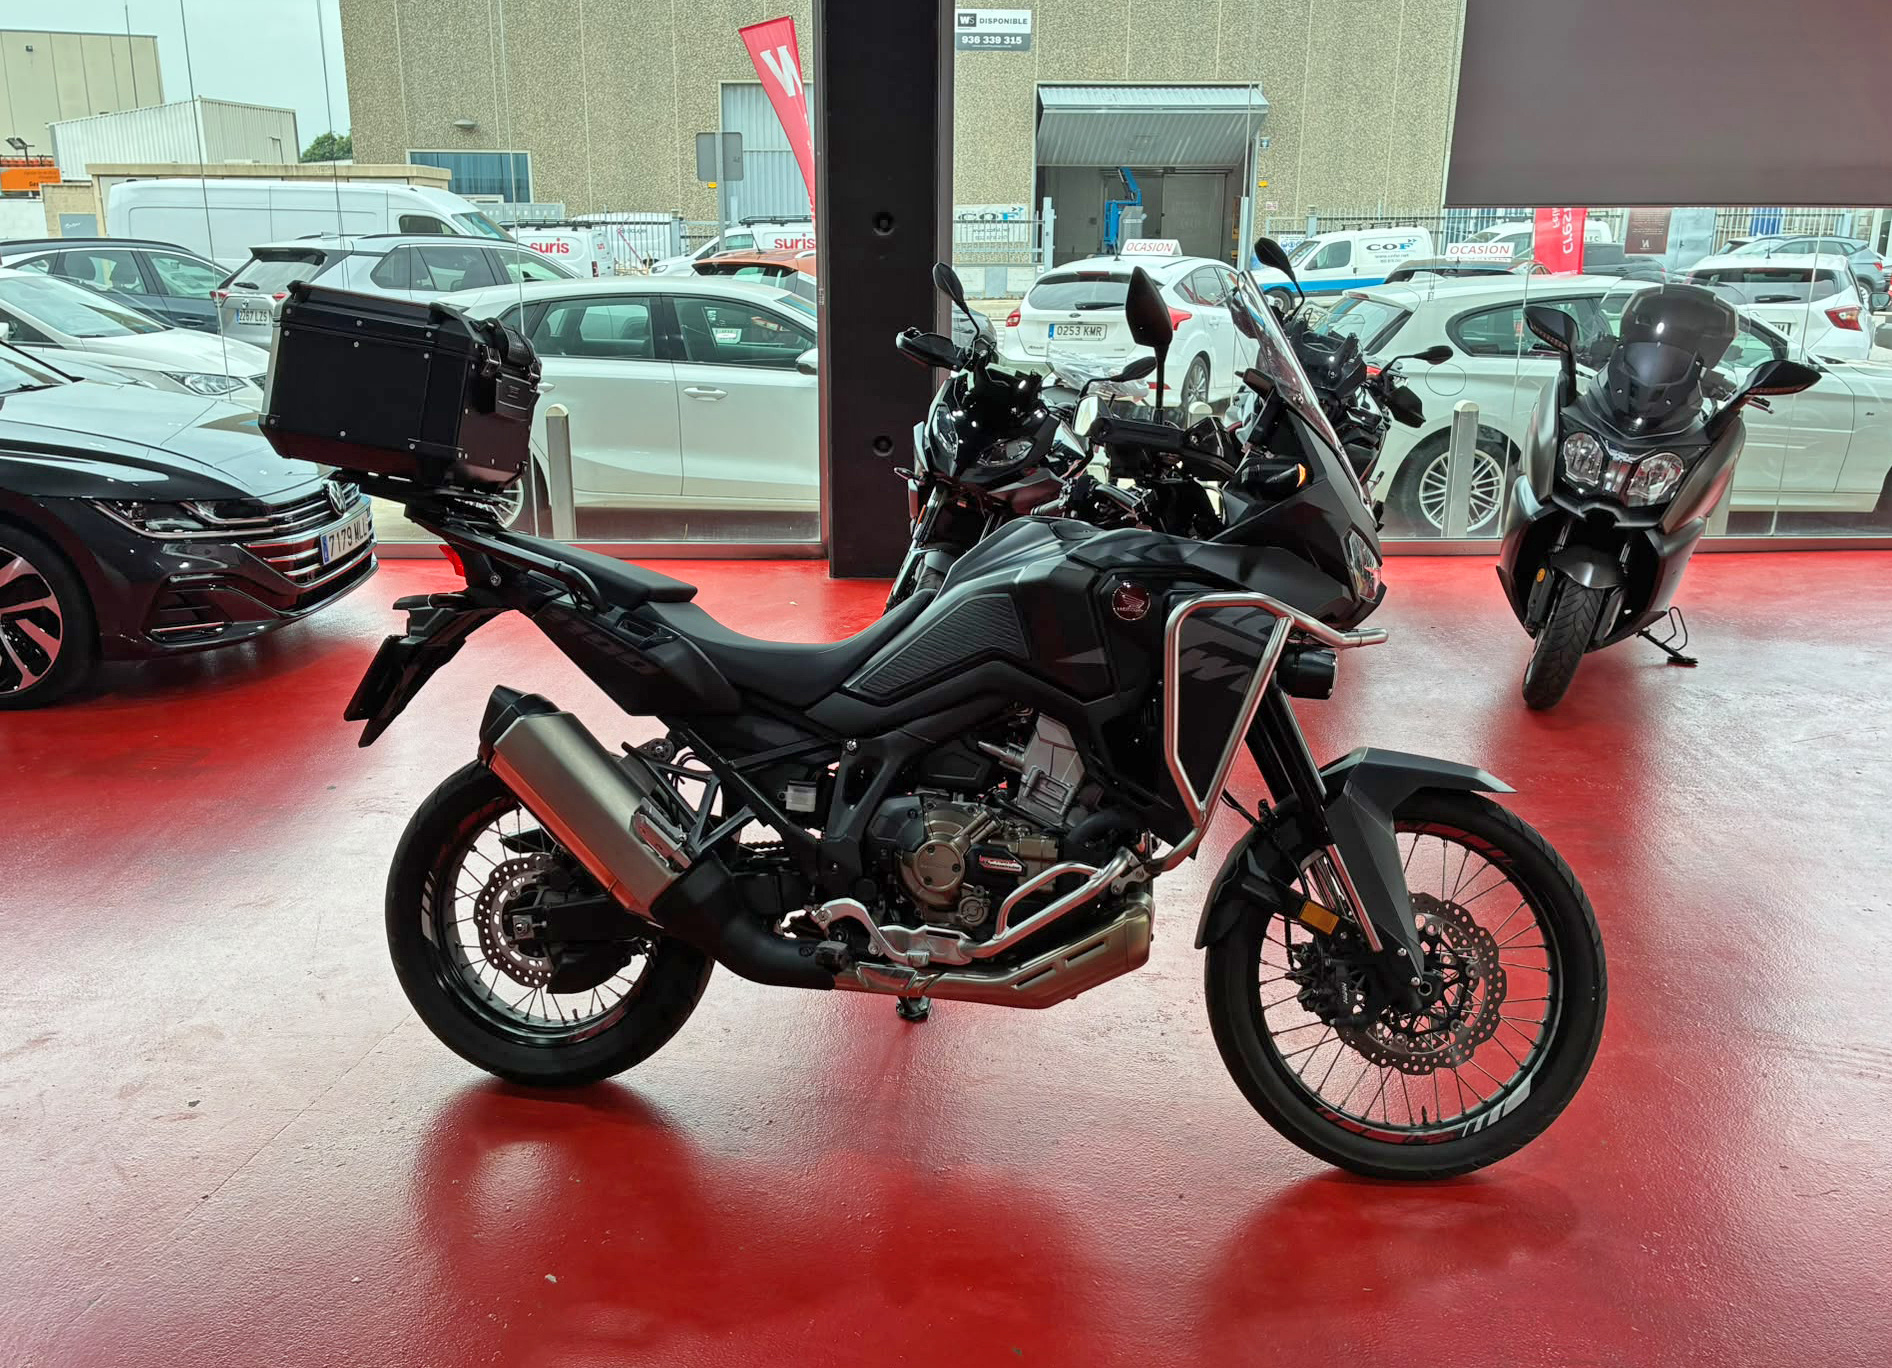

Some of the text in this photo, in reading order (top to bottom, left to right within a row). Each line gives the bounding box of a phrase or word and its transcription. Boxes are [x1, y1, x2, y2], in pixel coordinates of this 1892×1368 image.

[961, 35, 1022, 44] 936 339 315
[529, 237, 569, 254] suris
[774, 232, 816, 249] suris
[1126, 242, 1174, 253] OCASION
[1366, 242, 1414, 251] COF
[1449, 245, 1510, 255] OCASION
[1056, 325, 1103, 337] 0253 KMR
[328, 516, 368, 557] 7179 MLL
